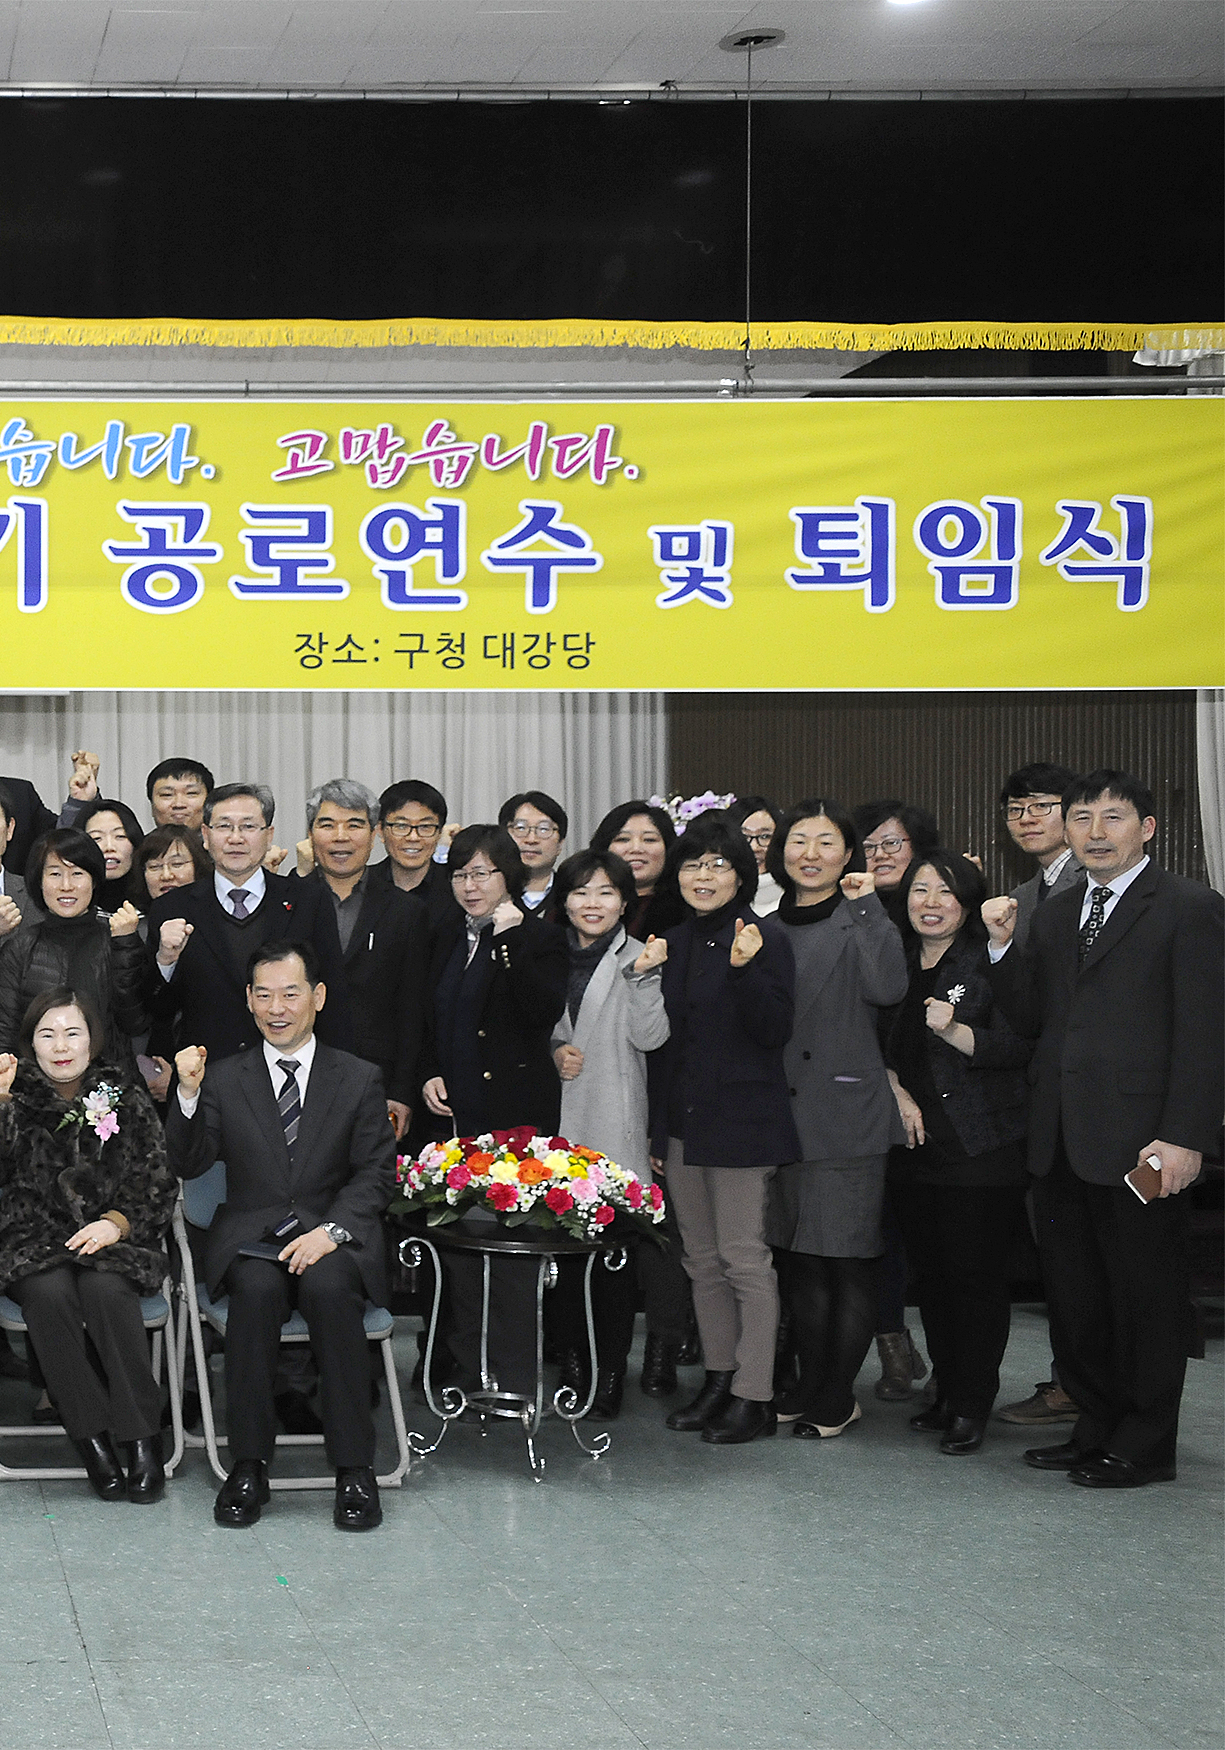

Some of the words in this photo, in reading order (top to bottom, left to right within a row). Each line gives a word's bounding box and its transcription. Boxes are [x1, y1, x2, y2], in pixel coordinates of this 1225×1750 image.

[274, 421, 637, 486] 고맙습니다.
[104, 499, 601, 612] 공로연수
[650, 521, 732, 607] 및
[787, 497, 1150, 611] 퇴임식
[294, 632, 379, 670] 장소:
[394, 632, 465, 670] 구청
[483, 632, 596, 670] 대강당
